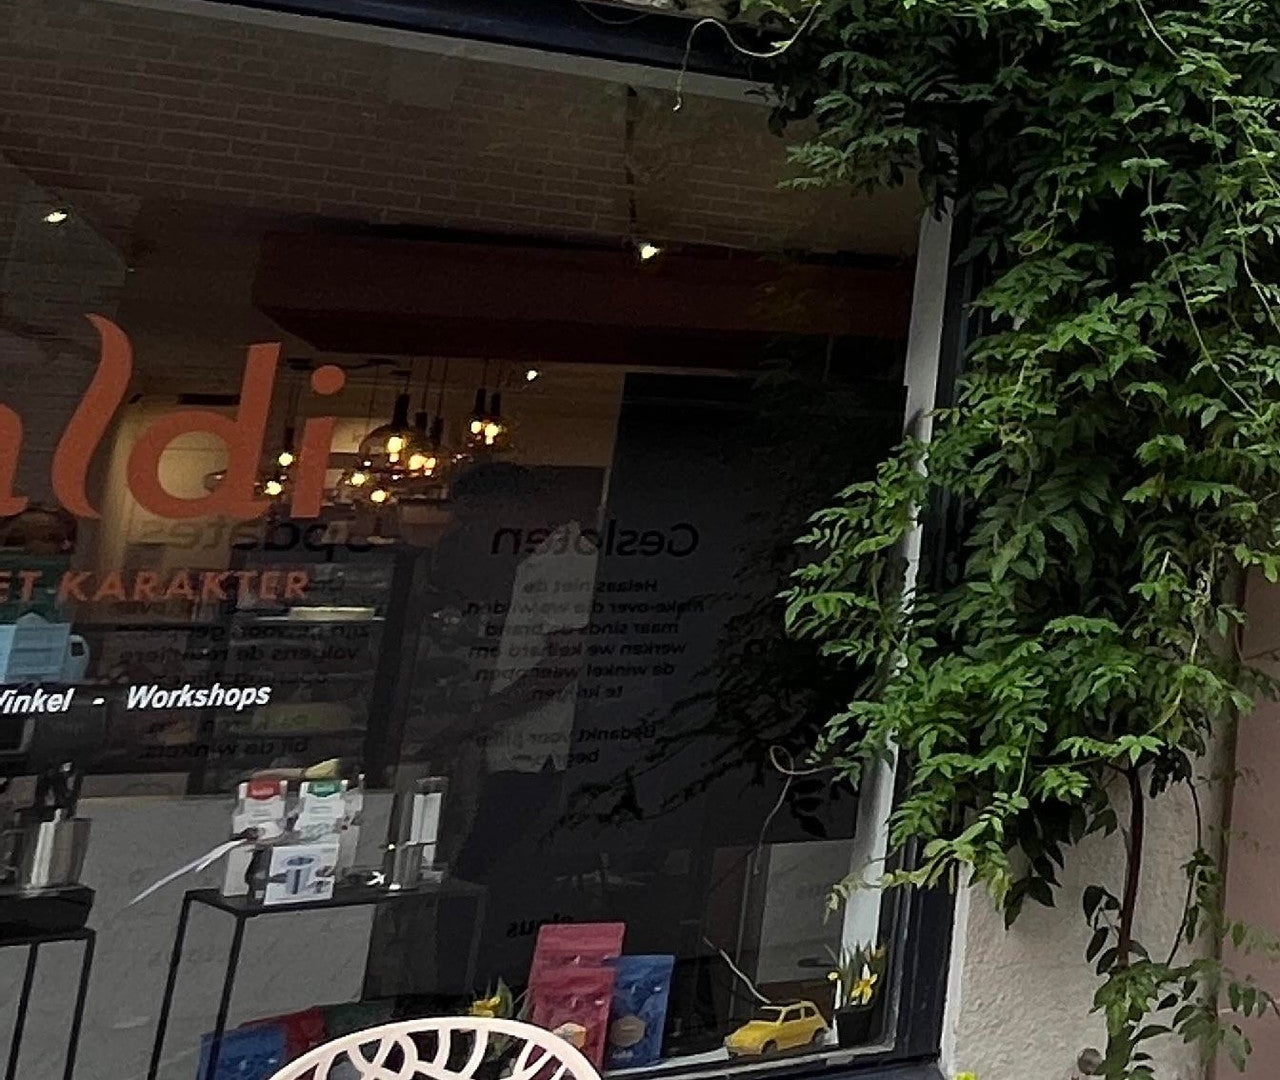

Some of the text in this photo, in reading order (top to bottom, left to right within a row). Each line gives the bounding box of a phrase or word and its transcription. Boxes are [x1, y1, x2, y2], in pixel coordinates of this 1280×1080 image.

[0, 313, 347, 518] ldi
[57, 570, 310, 601] KARAKTER
[127, 683, 272, 712] Workshops
